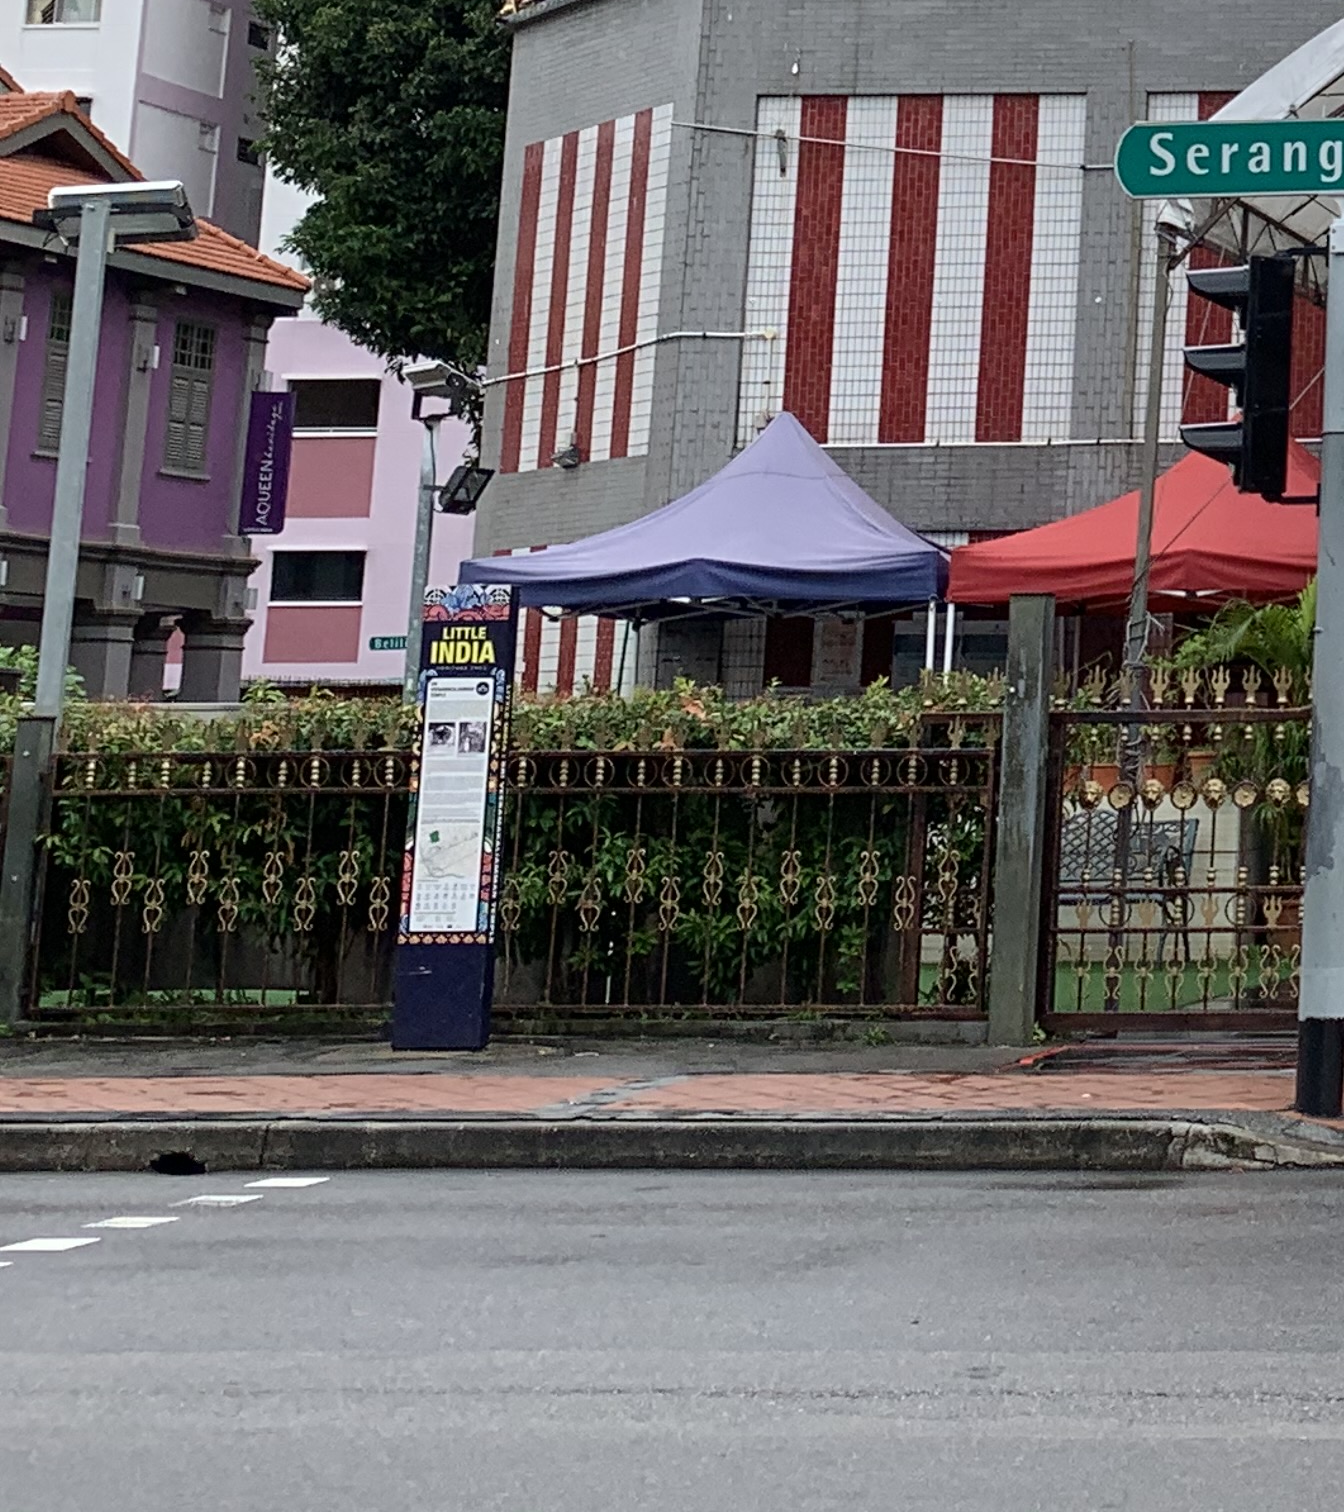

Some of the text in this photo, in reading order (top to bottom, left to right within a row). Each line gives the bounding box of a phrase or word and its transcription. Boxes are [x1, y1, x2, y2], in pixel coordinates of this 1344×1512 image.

[256, 460, 273, 526] AQUEEN
[442, 626, 487, 640] LITTLE
[430, 640, 495, 664] INDIA
